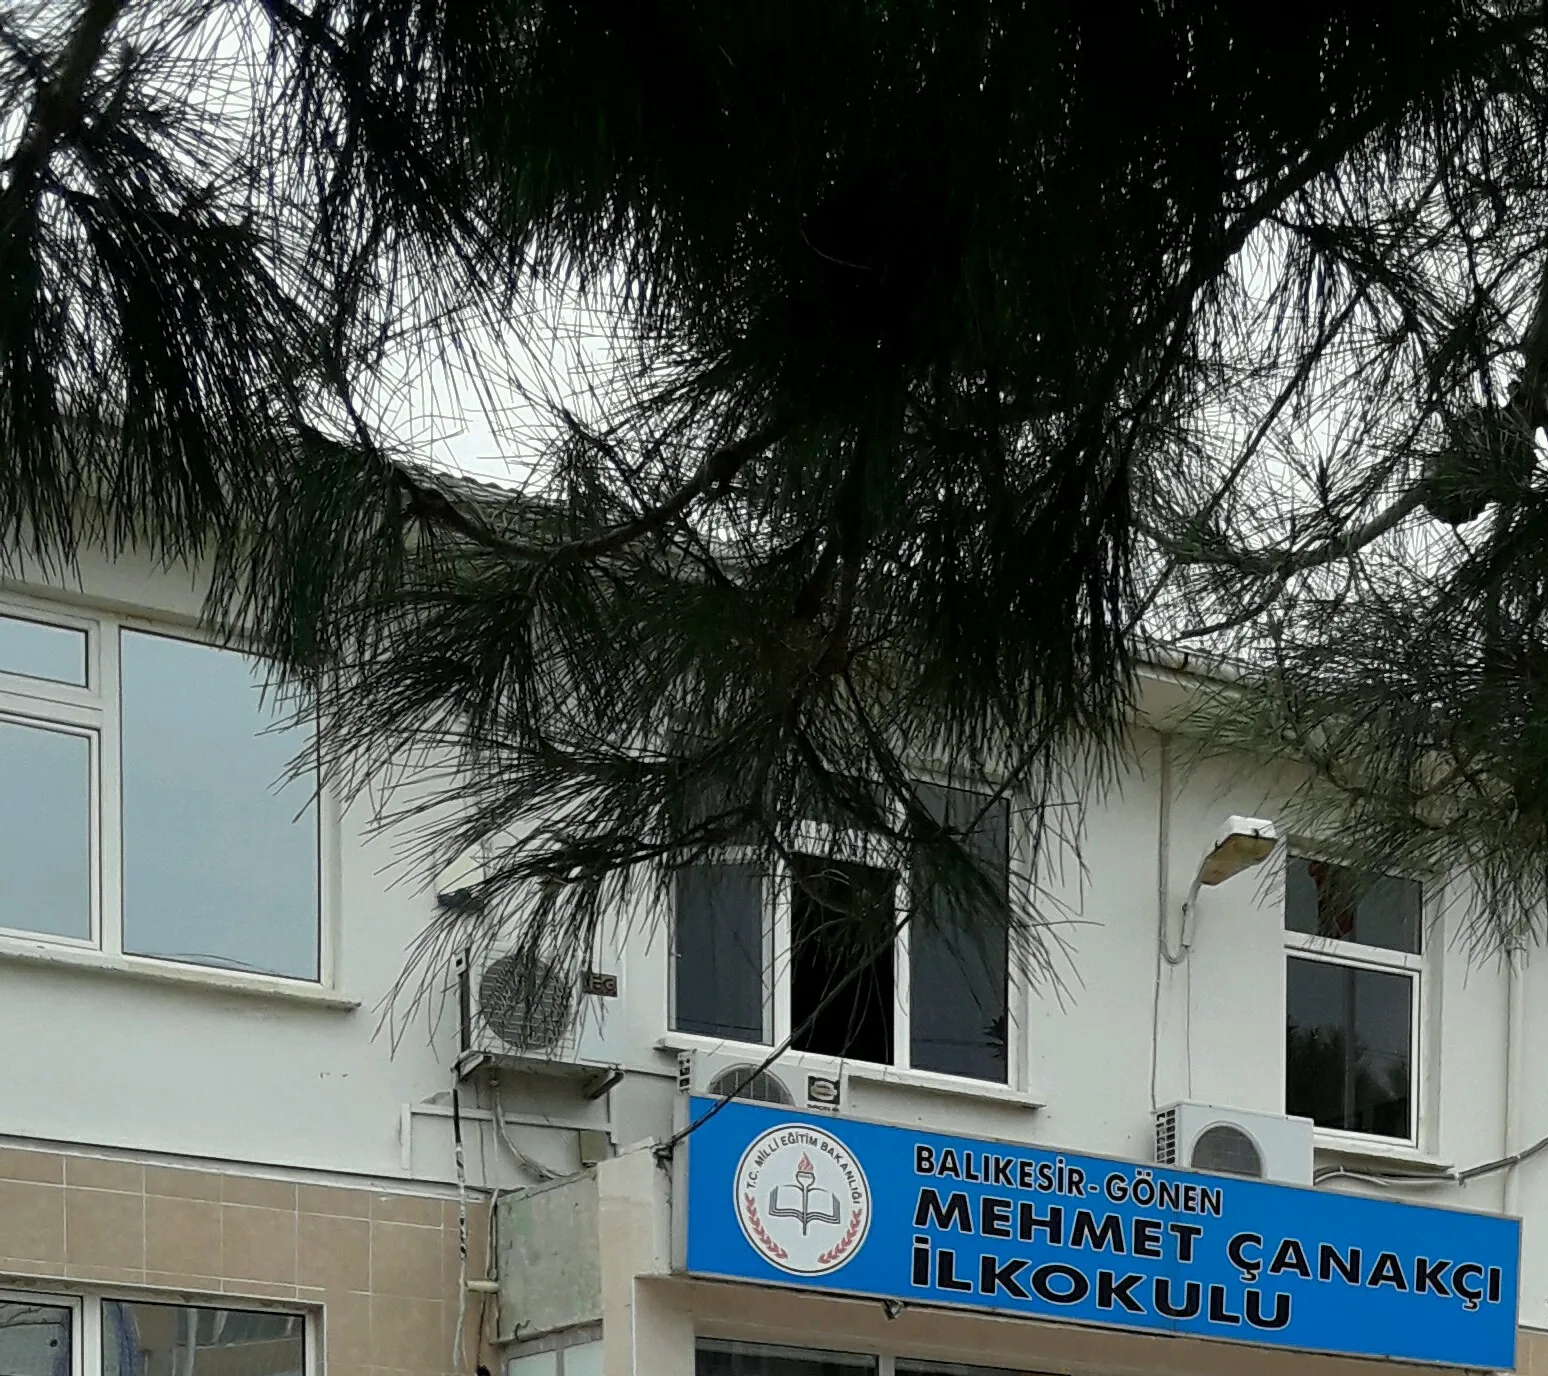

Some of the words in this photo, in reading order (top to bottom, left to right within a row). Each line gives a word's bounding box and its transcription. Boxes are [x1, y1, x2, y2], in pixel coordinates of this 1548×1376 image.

[754, 1139, 780, 1167] MİLLİ
[781, 1131, 818, 1148] EĞİTİM
[820, 1141, 863, 1204] BAKANLIĞI
[911, 1235, 1292, 1330] İLKOKULU
[913, 1187, 1203, 1265] MEHMET
[1227, 1232, 1502, 1311] ÇANAKÇI
